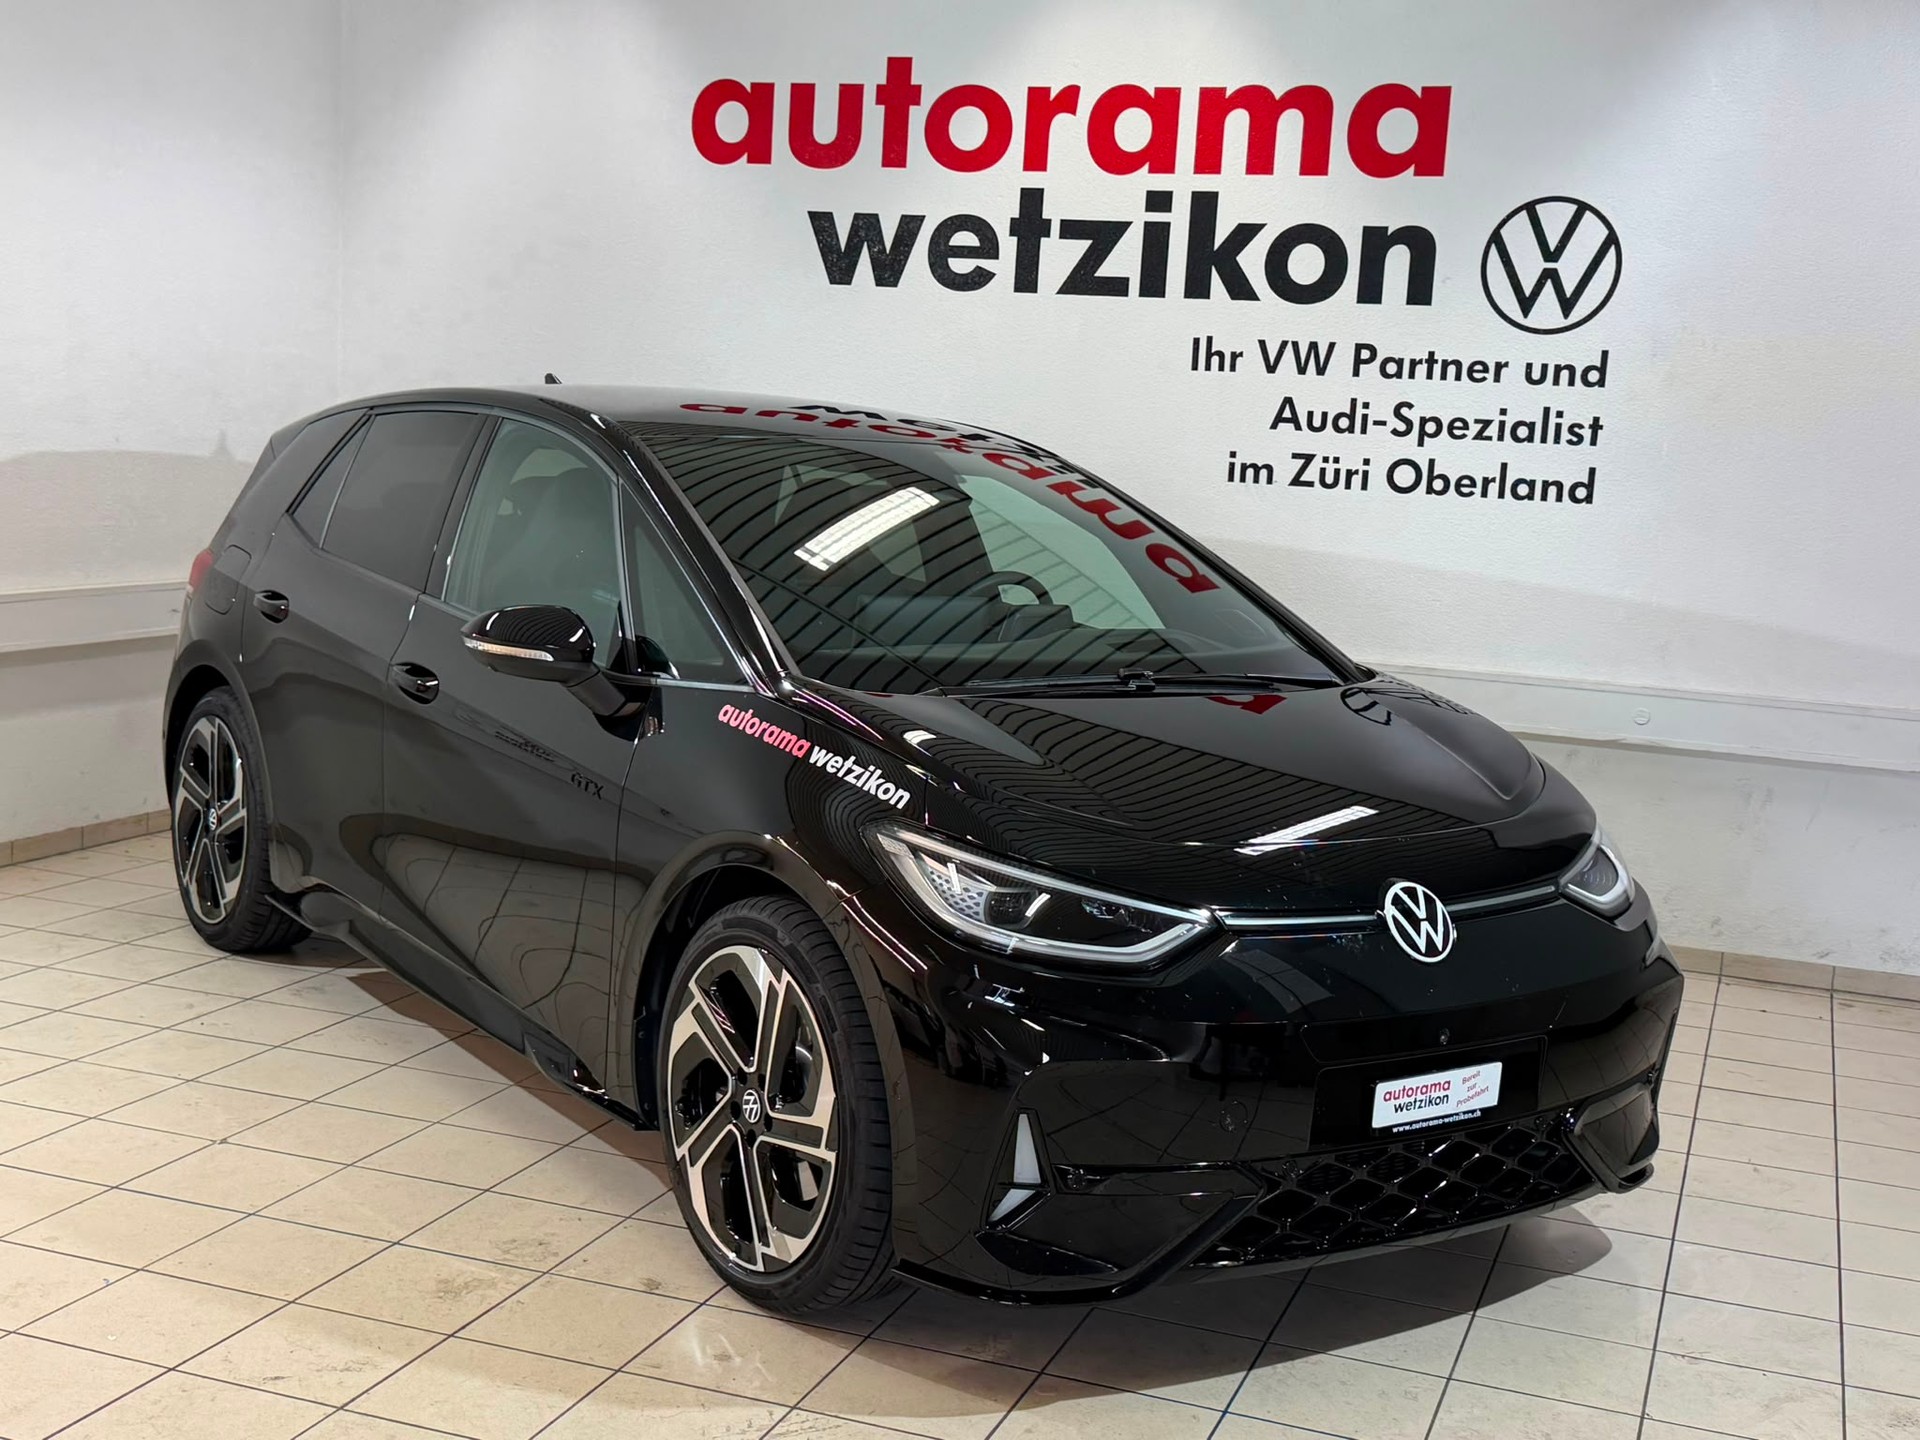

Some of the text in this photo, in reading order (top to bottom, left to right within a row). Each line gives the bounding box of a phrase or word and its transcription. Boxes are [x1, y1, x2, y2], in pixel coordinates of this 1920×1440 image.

[690, 56, 1453, 180] autorama
[807, 187, 1437, 306] wetzikon
[1481, 196, 1622, 335] VW
[1191, 336, 1609, 388] Ihr VW Partner und
[1269, 396, 1604, 448] Audi-Spezialist
[1227, 450, 1597, 505] im Züri Oberland
[717, 703, 911, 810] autorama wetzikon
[570, 772, 604, 800] GTX
[1384, 881, 1453, 963] VW
[1383, 1080, 1452, 1103] autorama
[1456, 1085, 1490, 1108] Probefahrt
[1461, 1070, 1481, 1085] Bereit
[1466, 1082, 1478, 1093] zur
[1392, 1109, 1482, 1133] www.autorama-wetzikon.ch
[1394, 1094, 1450, 1114] wetzikon
